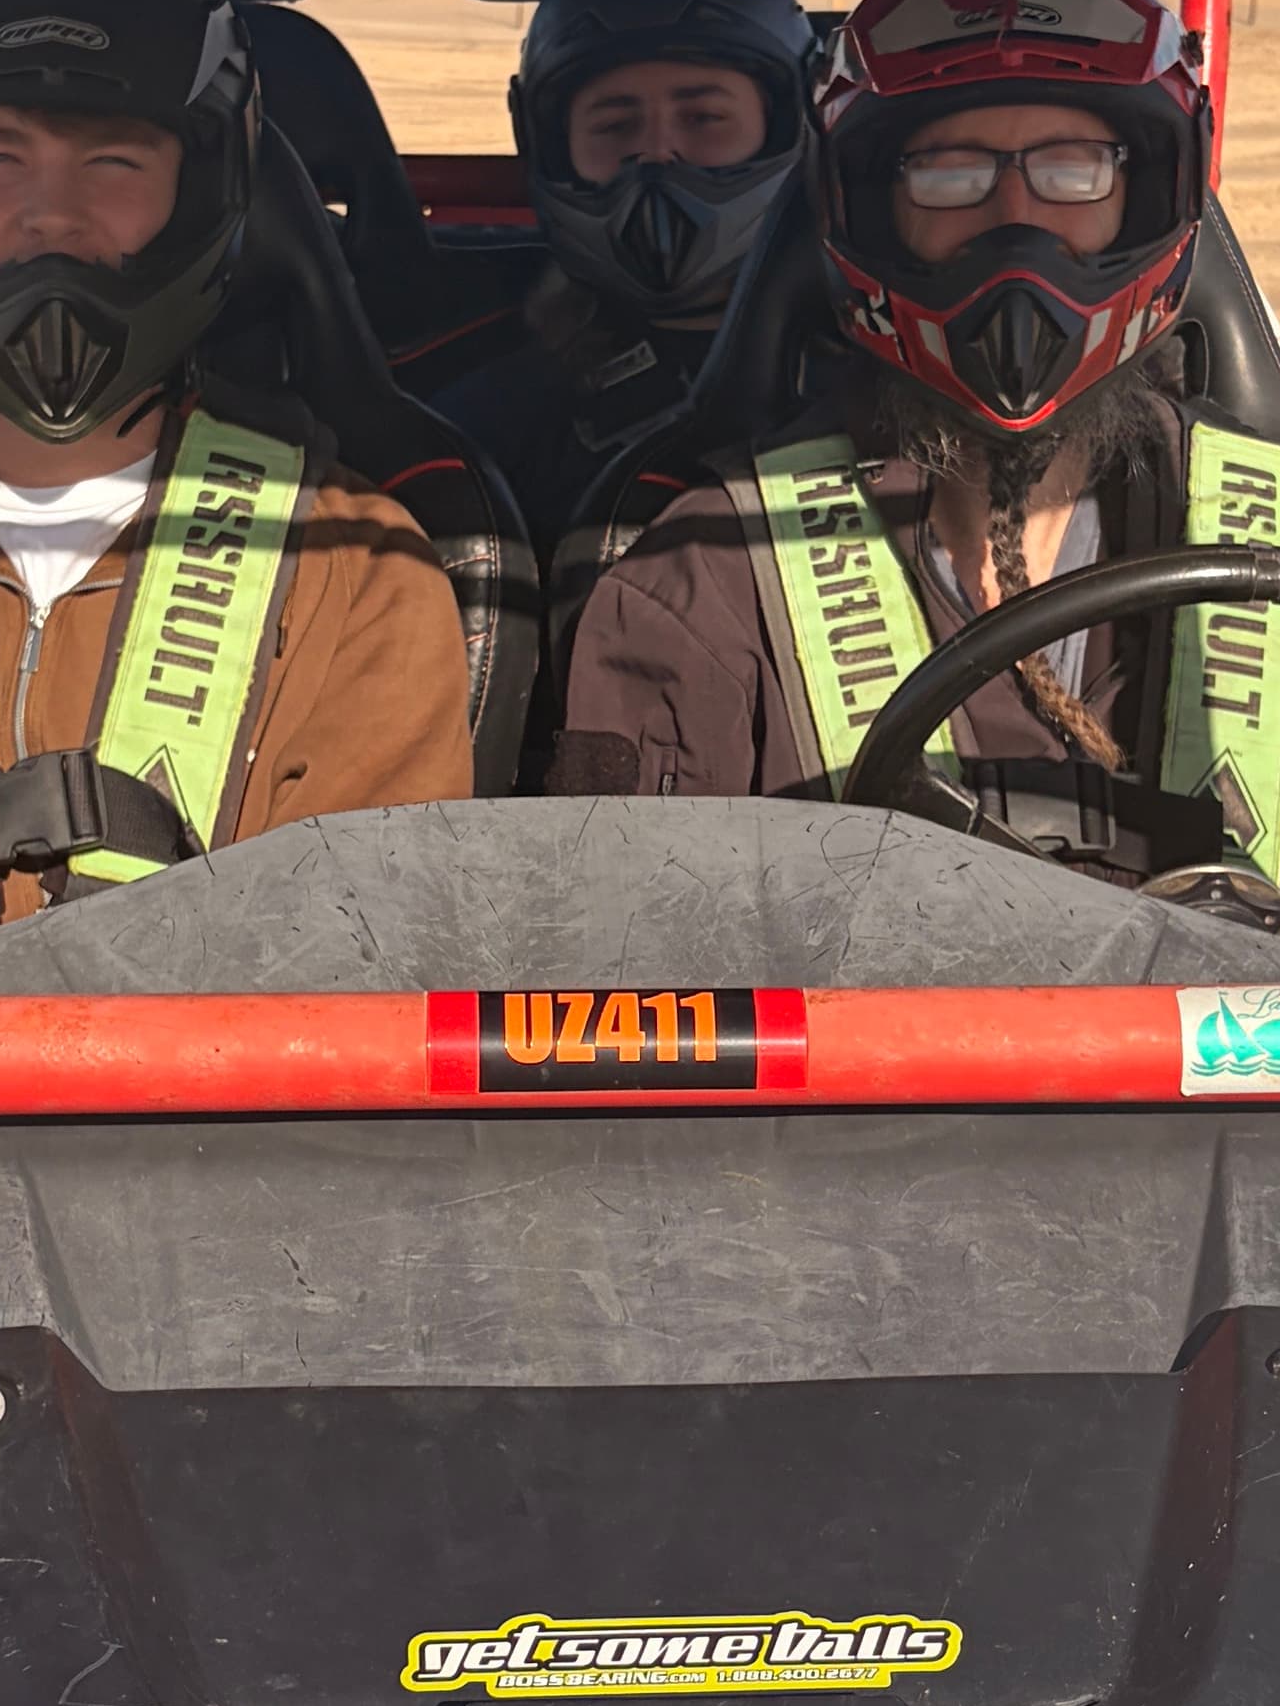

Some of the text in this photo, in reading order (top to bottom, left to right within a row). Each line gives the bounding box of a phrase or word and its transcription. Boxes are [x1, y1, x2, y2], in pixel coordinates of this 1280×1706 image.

[143, 450, 267, 726] ASSAULT
[504, 991, 718, 1064] UZ411
[417, 1621, 946, 1679] get some balls
